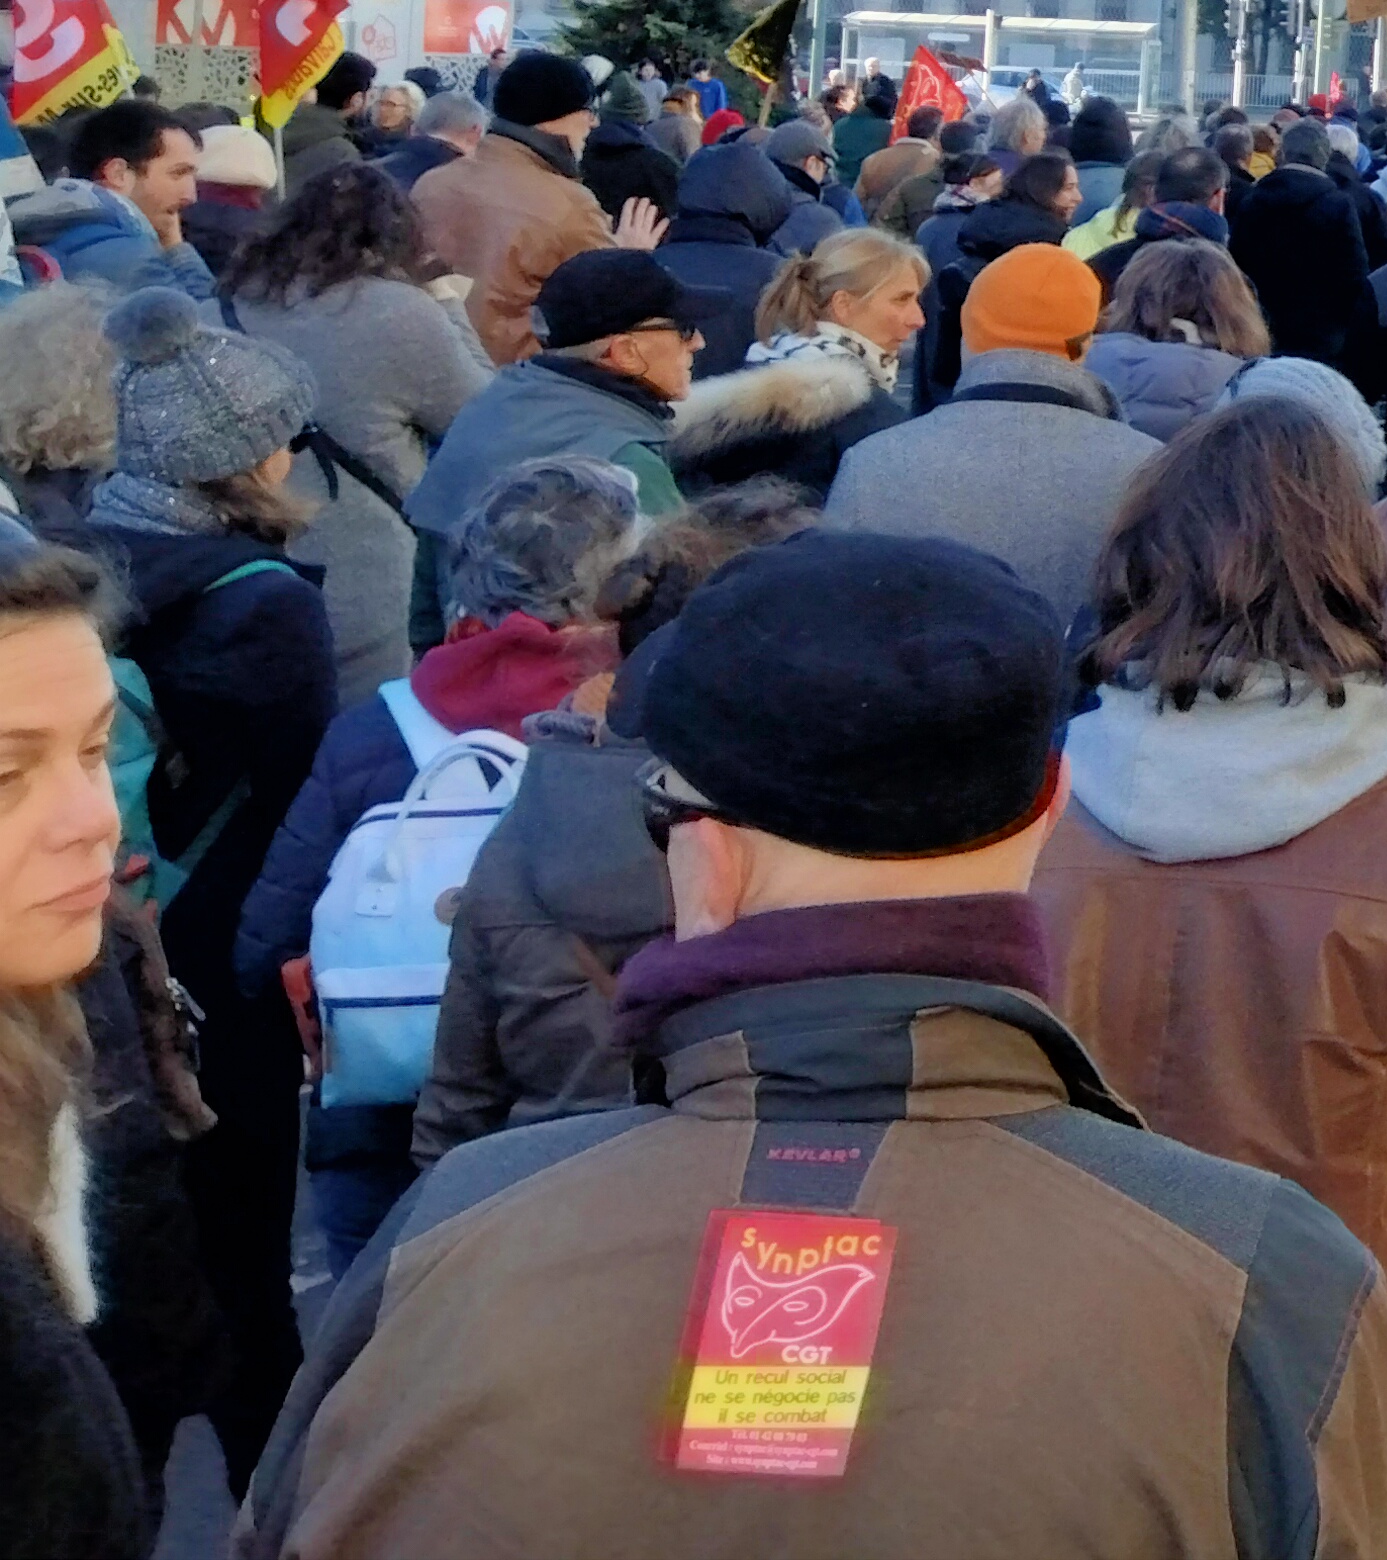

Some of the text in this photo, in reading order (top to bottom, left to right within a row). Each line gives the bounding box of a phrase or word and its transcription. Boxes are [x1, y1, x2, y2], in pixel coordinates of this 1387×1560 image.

[781, 1344, 833, 1365] CGT
[715, 1369, 847, 1385] Un recul social
[694, 1388, 856, 1407] ne se négocie pas
[717, 1408, 828, 1424] il se combat
